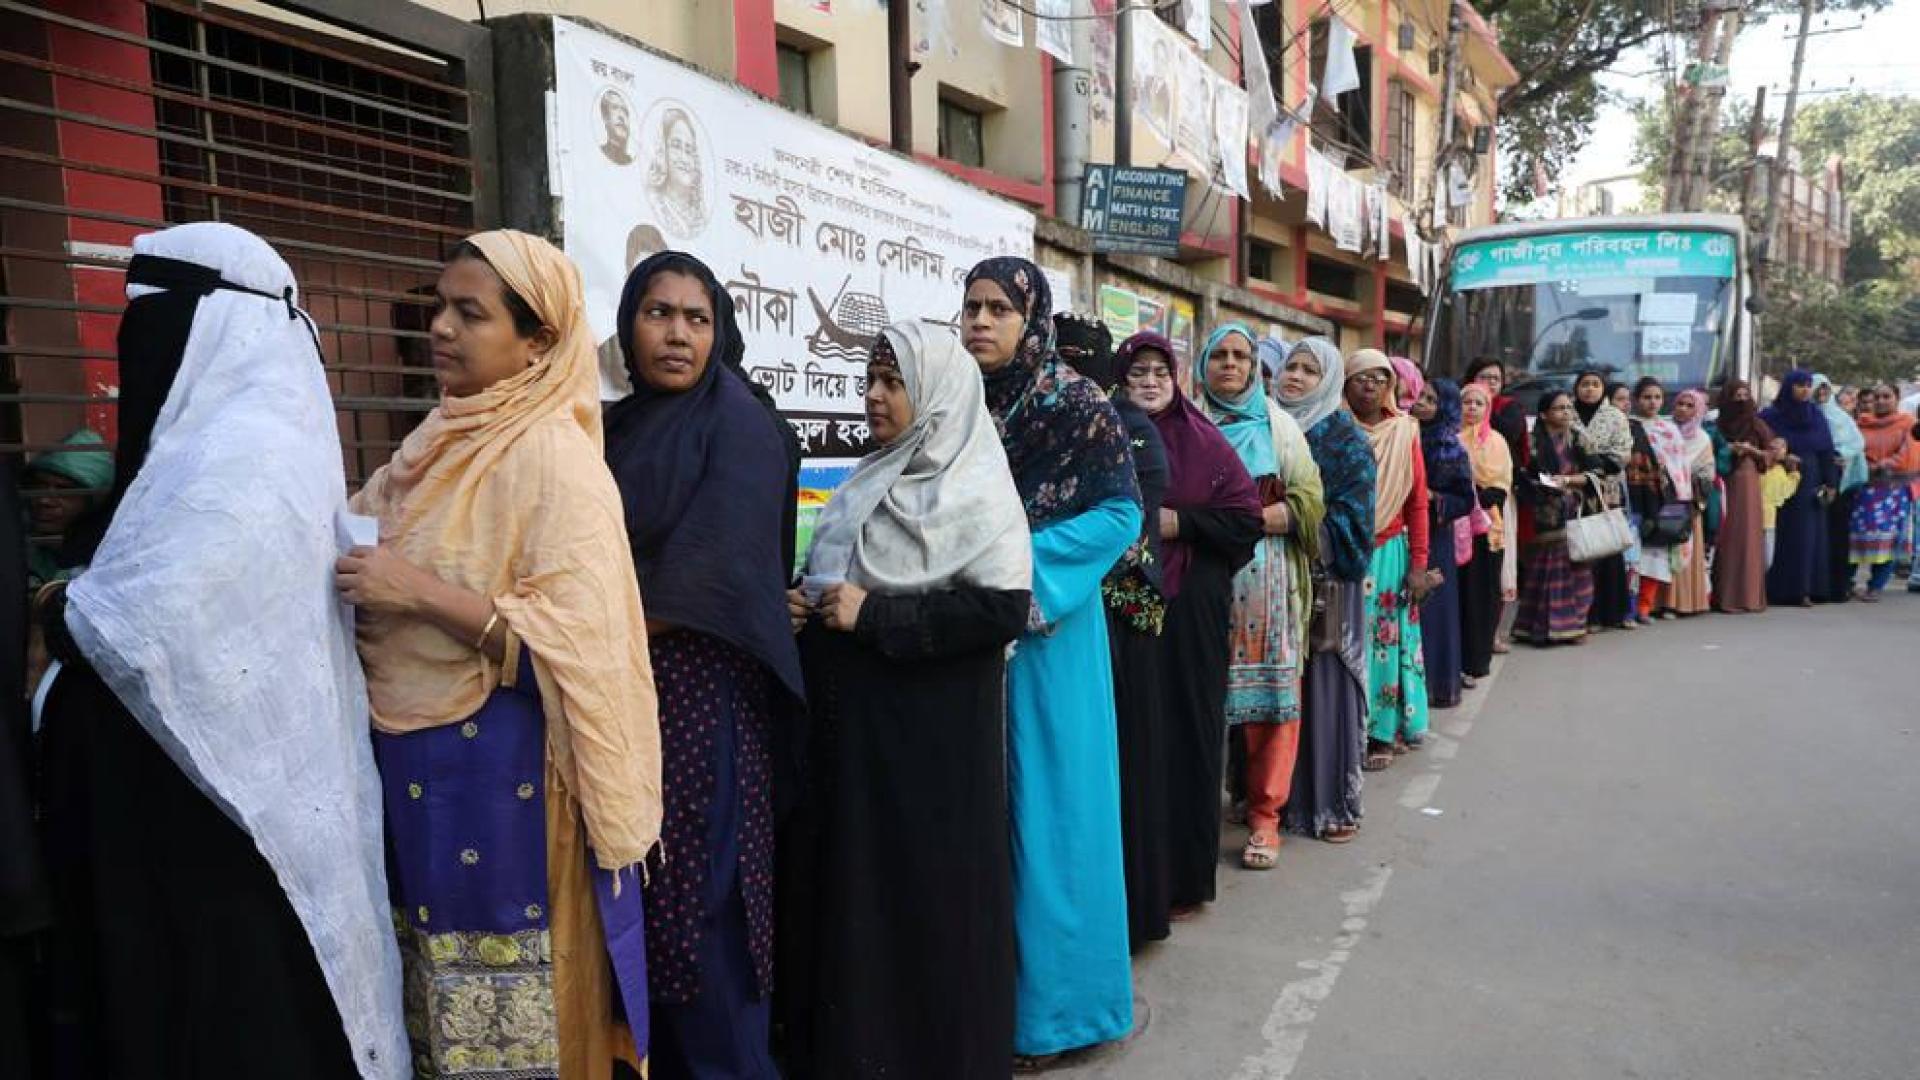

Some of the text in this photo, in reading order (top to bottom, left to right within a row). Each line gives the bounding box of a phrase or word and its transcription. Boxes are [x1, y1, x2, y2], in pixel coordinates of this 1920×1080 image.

[1115, 169, 1184, 187] ACCOUNTING
[1082, 168, 1105, 232] AIM
[1112, 185, 1171, 203] FINANCE
[729, 192, 806, 245] হাজী
[816, 222, 865, 263] মোঃ
[877, 236, 945, 279] সেলিম
[1109, 219, 1169, 236] ENGLISH
[1490, 240, 1562, 264] গাজীপুর
[1572, 236, 1648, 256] পরিবহন
[751, 359, 797, 396] ভোট
[803, 361, 848, 398] দিয়ে
[787, 418, 831, 453] মুল
